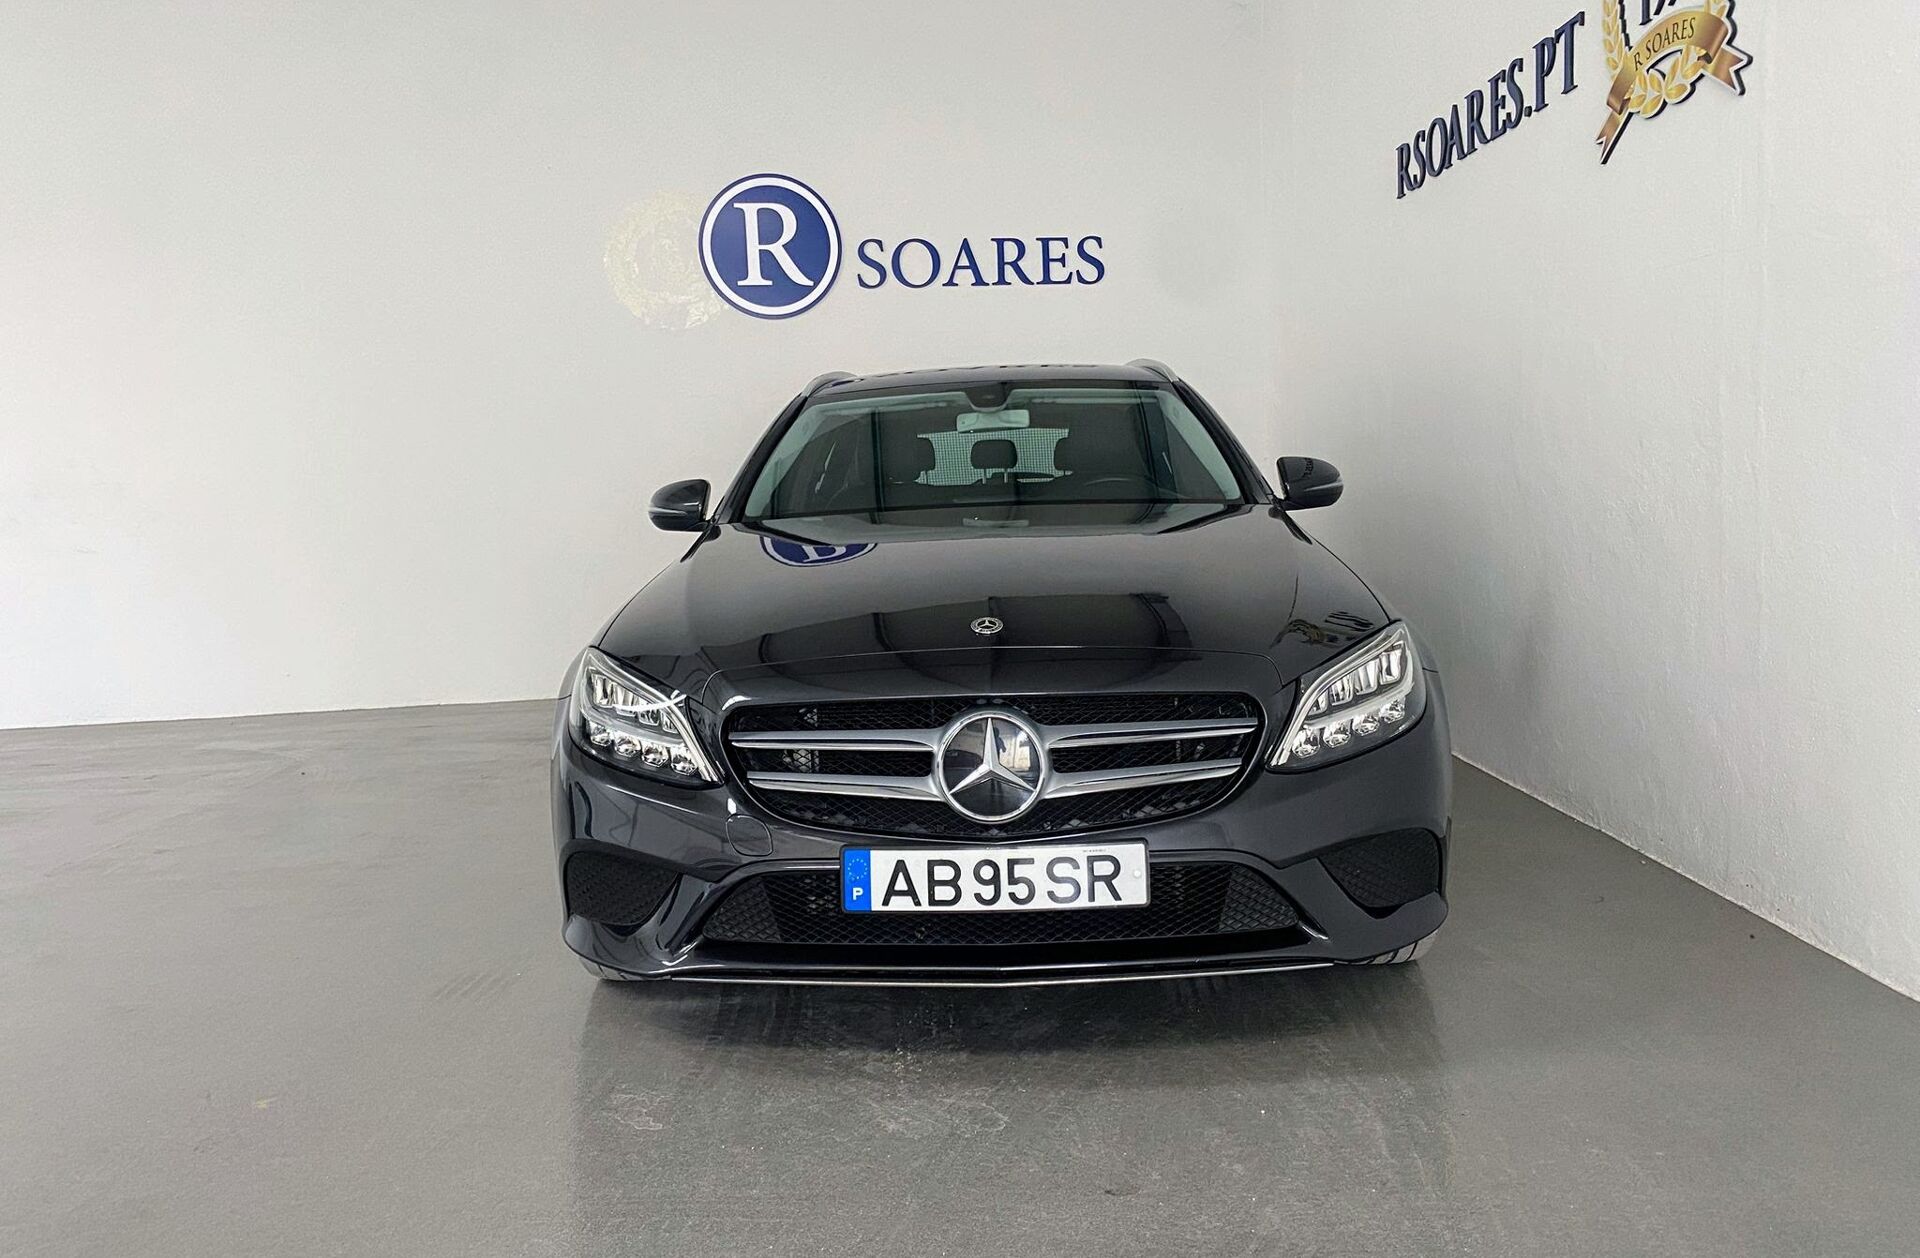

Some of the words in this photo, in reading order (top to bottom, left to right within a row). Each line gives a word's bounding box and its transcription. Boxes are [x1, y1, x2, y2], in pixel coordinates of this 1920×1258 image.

[1633, 52, 1642, 71] R
[1645, 17, 1696, 60] SOARES
[1396, 11, 1586, 199] RSOARES.PT
[733, 202, 814, 287] R
[857, 234, 1106, 290] SOARES
[852, 887, 864, 901] P
